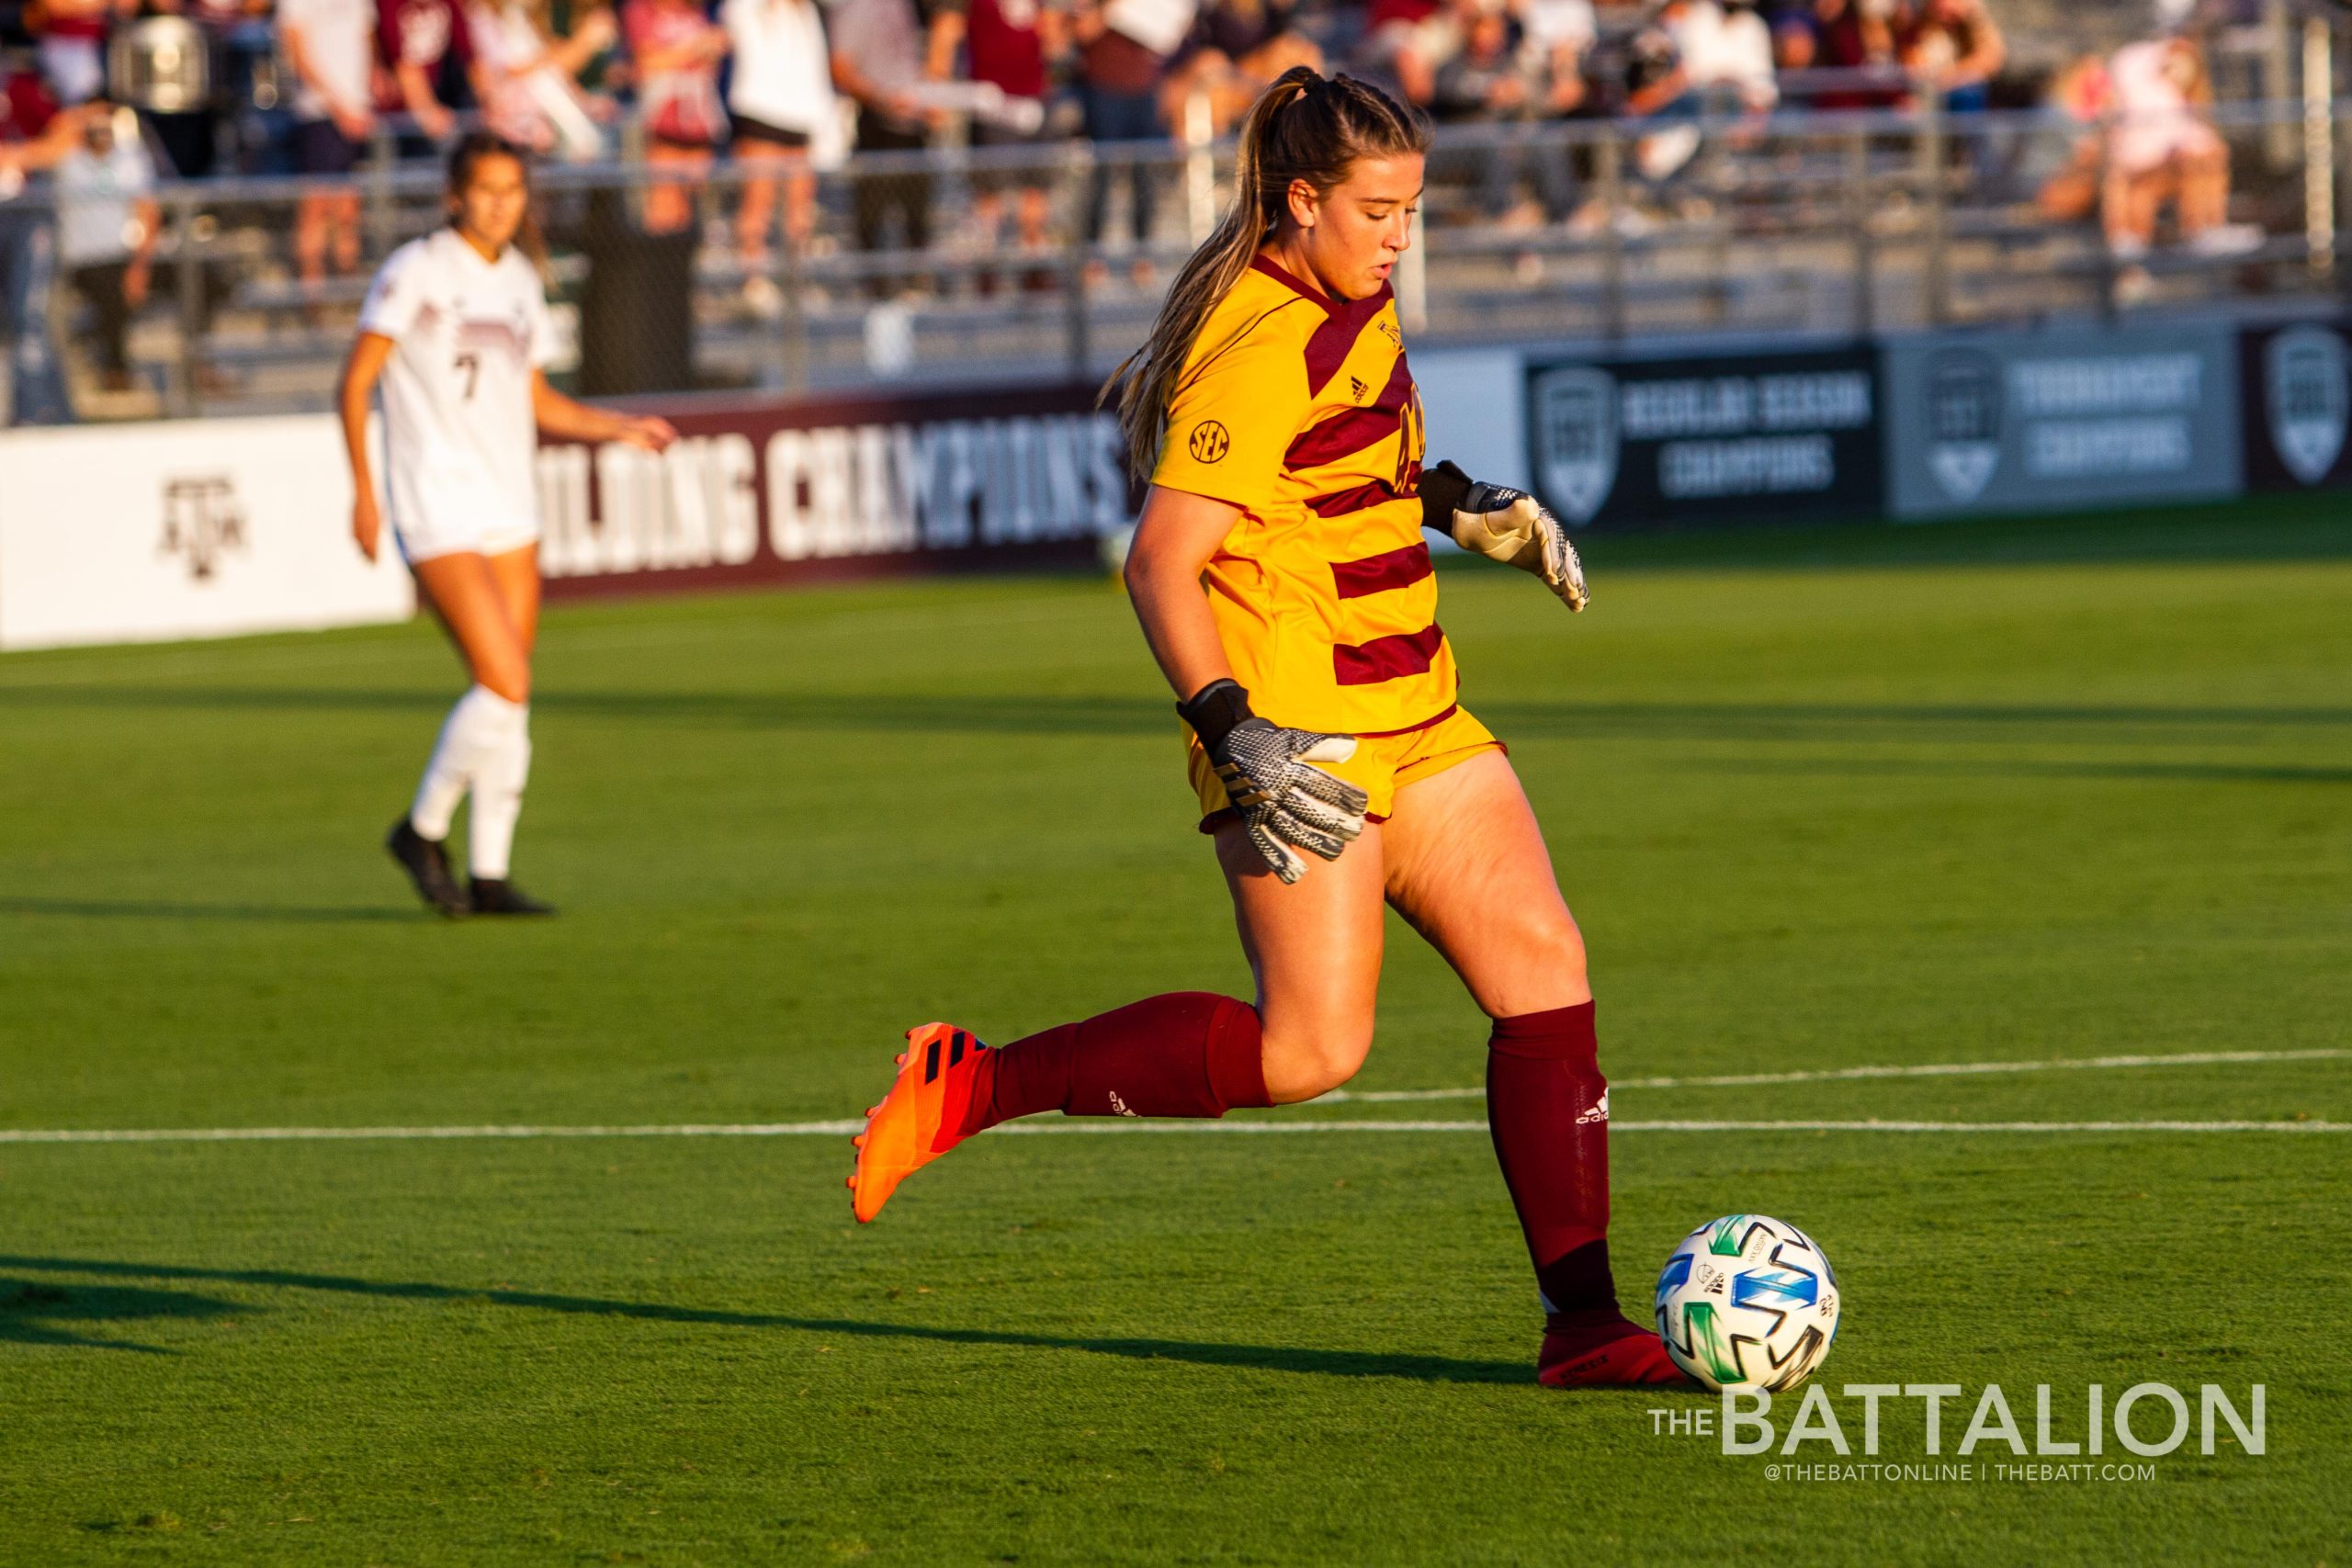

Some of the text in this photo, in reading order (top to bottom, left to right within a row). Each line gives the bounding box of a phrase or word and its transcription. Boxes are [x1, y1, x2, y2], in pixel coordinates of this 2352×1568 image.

[453, 351, 479, 401] 7
[1191, 421, 1229, 463] SEC
[537, 413, 1128, 579] ILDING CHAMPIONS
